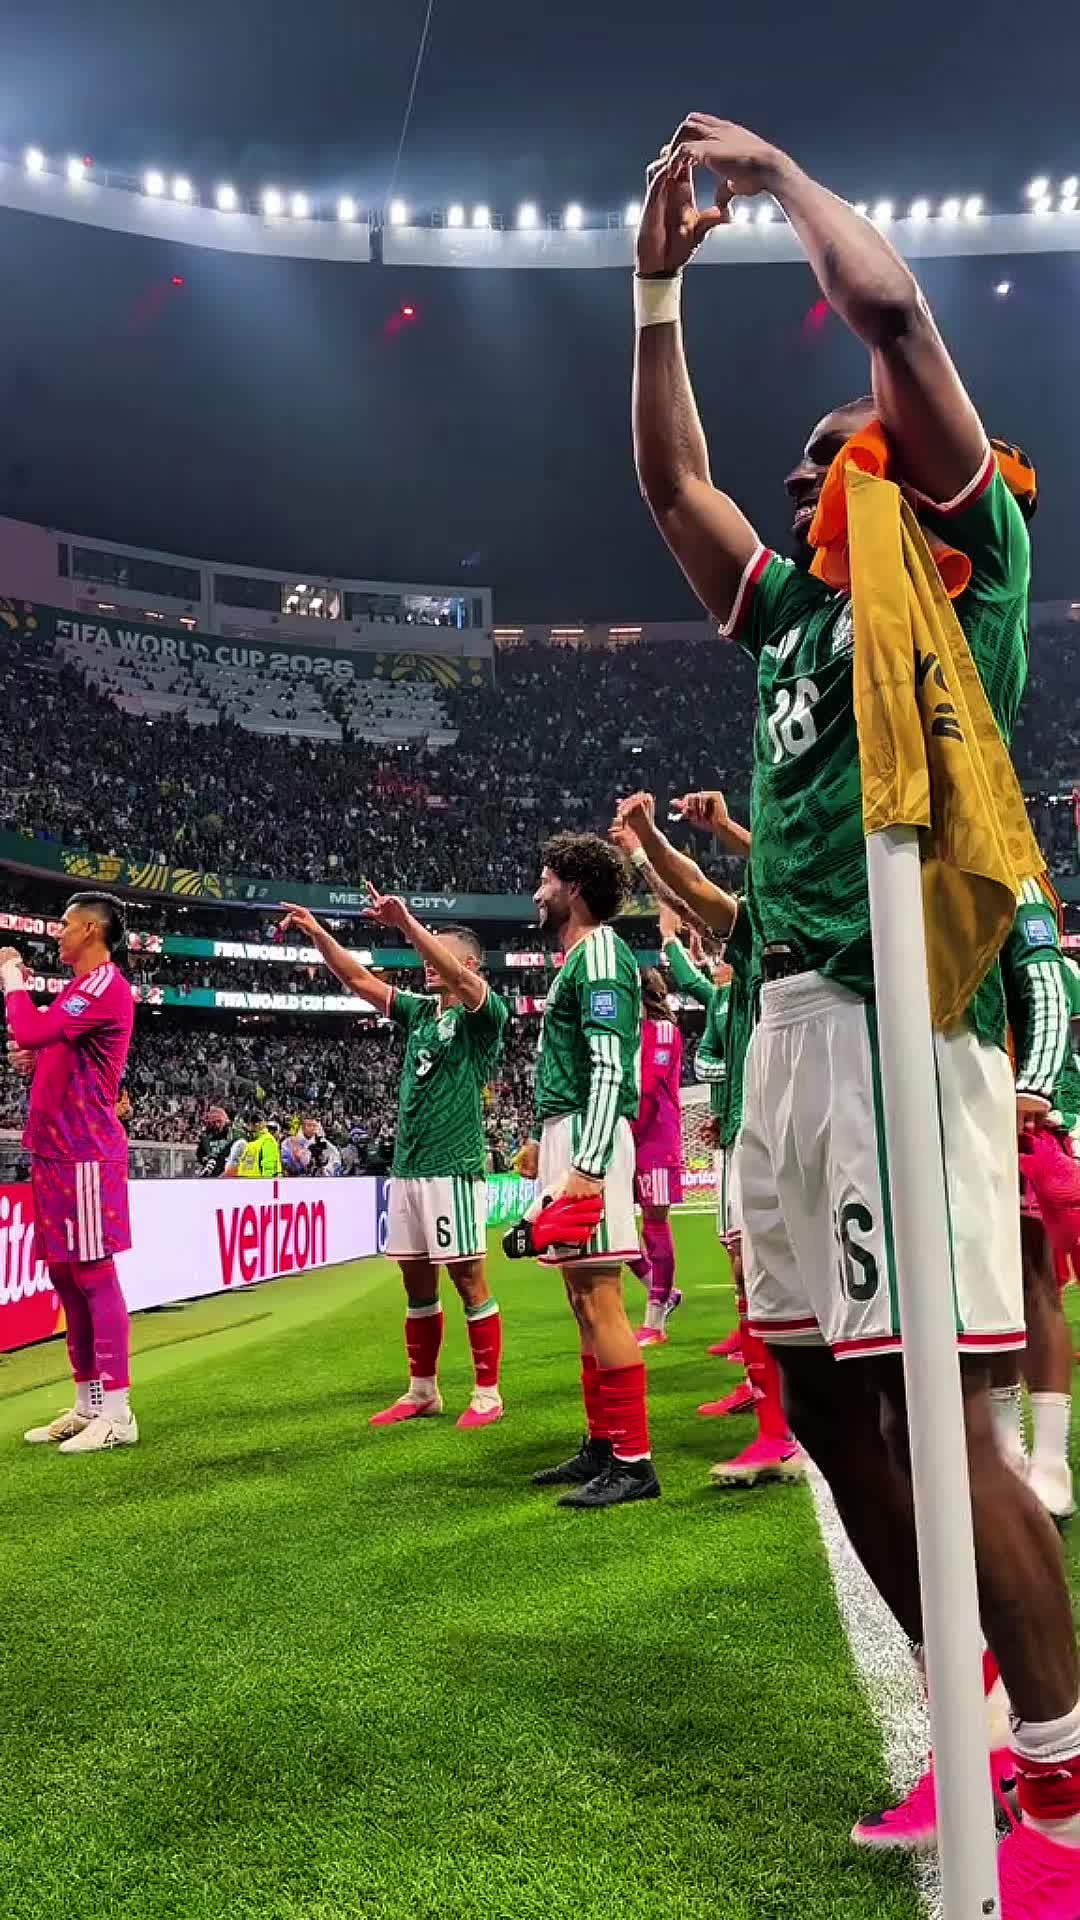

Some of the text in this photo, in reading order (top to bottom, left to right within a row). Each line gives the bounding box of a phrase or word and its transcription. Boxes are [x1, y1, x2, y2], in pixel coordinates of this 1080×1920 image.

[56, 620, 354, 678] FIFA WORLD CUP 2026
[411, 896, 457, 909] CITY
[215, 1180, 327, 1285] verizon
[435, 1215, 452, 1248] 6
